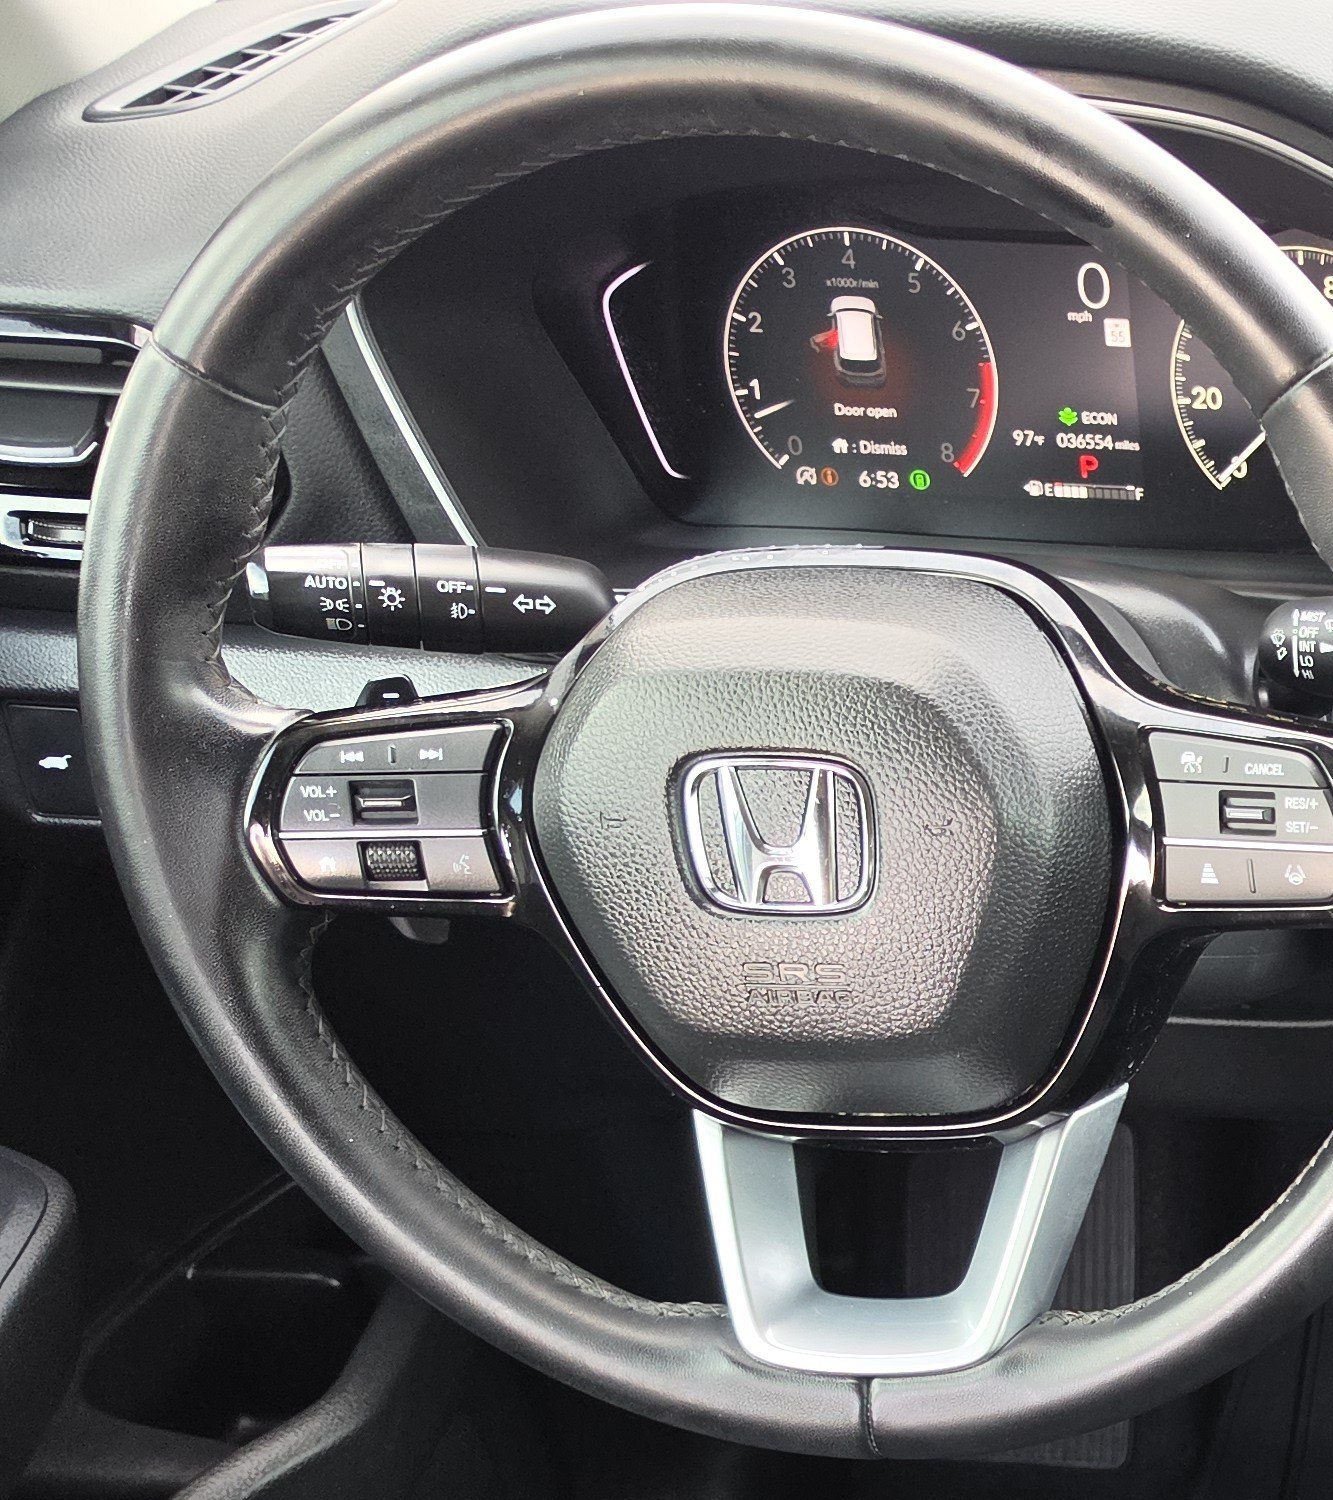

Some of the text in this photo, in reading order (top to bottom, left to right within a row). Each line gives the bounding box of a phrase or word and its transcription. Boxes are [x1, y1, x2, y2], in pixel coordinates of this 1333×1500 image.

[841, 250, 856, 269] 4
[782, 267, 796, 288] 3
[908, 272, 921, 294] 5
[1077, 262, 1110, 309] 0
[749, 312, 763, 333] 2
[1067, 310, 1093, 324] mph
[952, 320, 966, 342] 6
[749, 379, 761, 400] 1
[967, 388, 980, 409] 7
[1190, 386, 1223, 410] 20
[834, 402, 898, 421] Door open
[1081, 411, 1118, 426] ECON
[787, 436, 803, 456] 0
[859, 440, 908, 457] Dismiss
[1056, 433, 1113, 450] 036554
[940, 443, 955, 463] 8
[1080, 455, 1099, 478] P
[858, 471, 900, 489] 6:53
[1045, 483, 1144, 501] E F
[305, 575, 348, 591] AUTO
[437, 579, 466, 594] OFF
[1300, 610, 1326, 624] MIST
[1299, 627, 1319, 639] OFF
[1299, 640, 1317, 653] INT
[1300, 654, 1314, 668] LO
[1301, 669, 1315, 680] HI
[1244, 763, 1285, 776] CANCEL
[300, 785, 338, 799] VOL+
[1284, 797, 1319, 811] RES/+
[743, 961, 847, 983] SRS
[748, 989, 854, 1006] AIRBAG
